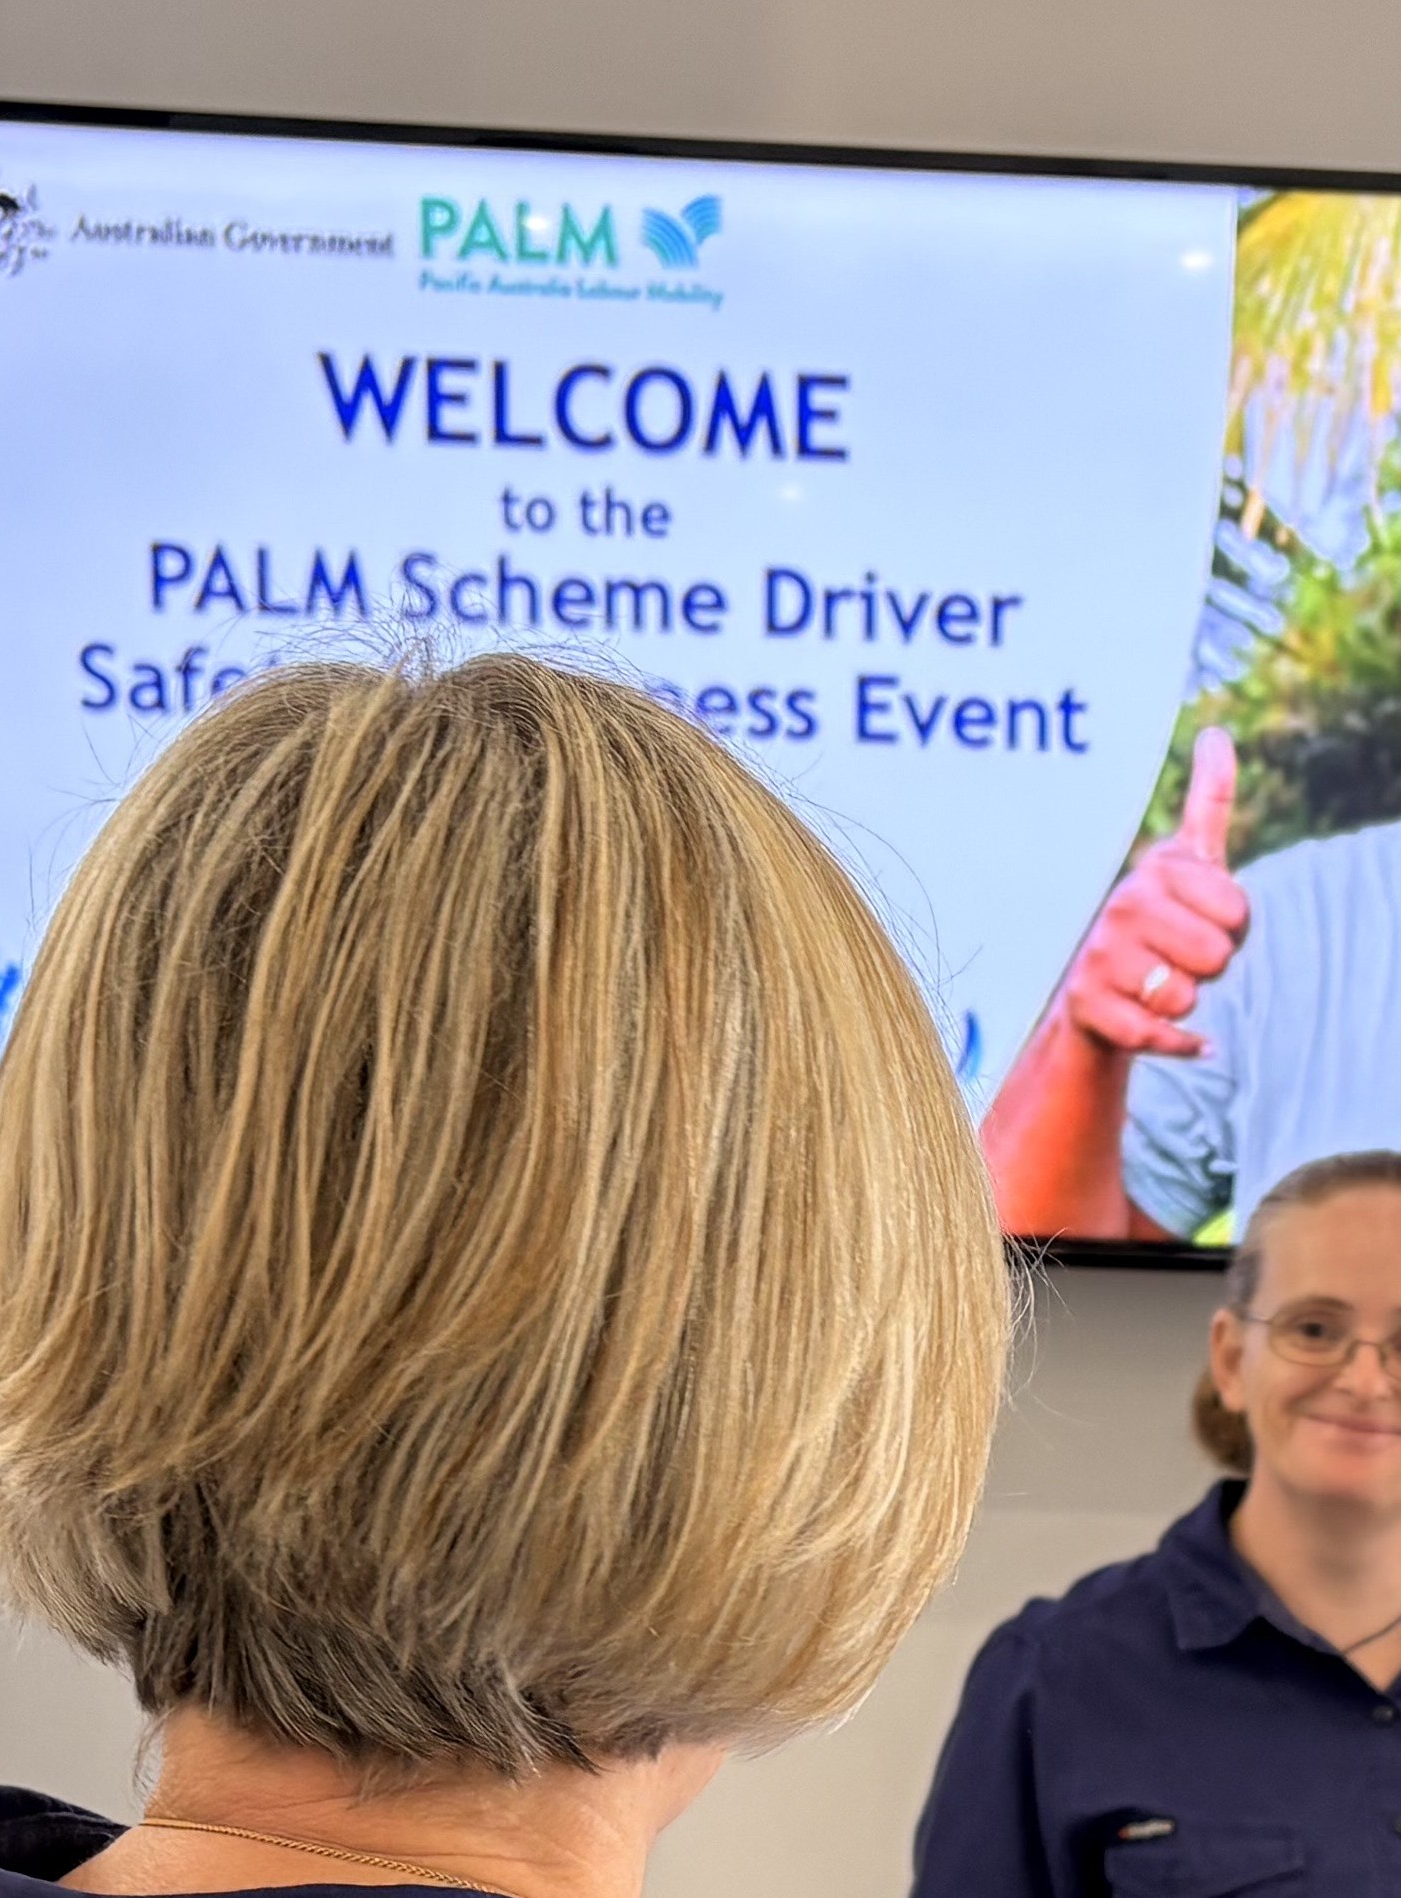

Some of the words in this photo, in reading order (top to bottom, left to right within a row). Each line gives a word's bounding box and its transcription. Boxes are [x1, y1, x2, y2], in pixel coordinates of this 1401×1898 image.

[70, 212, 216, 249] Australian
[223, 220, 394, 258] Government
[420, 197, 618, 268] PALM
[318, 349, 849, 463] WELCOME
[501, 487, 556, 535] to
[579, 488, 671, 539] the
[150, 542, 371, 617] PALM
[402, 552, 727, 635] Scheme
[764, 569, 1023, 649] Driver
[855, 675, 1089, 752] Event
